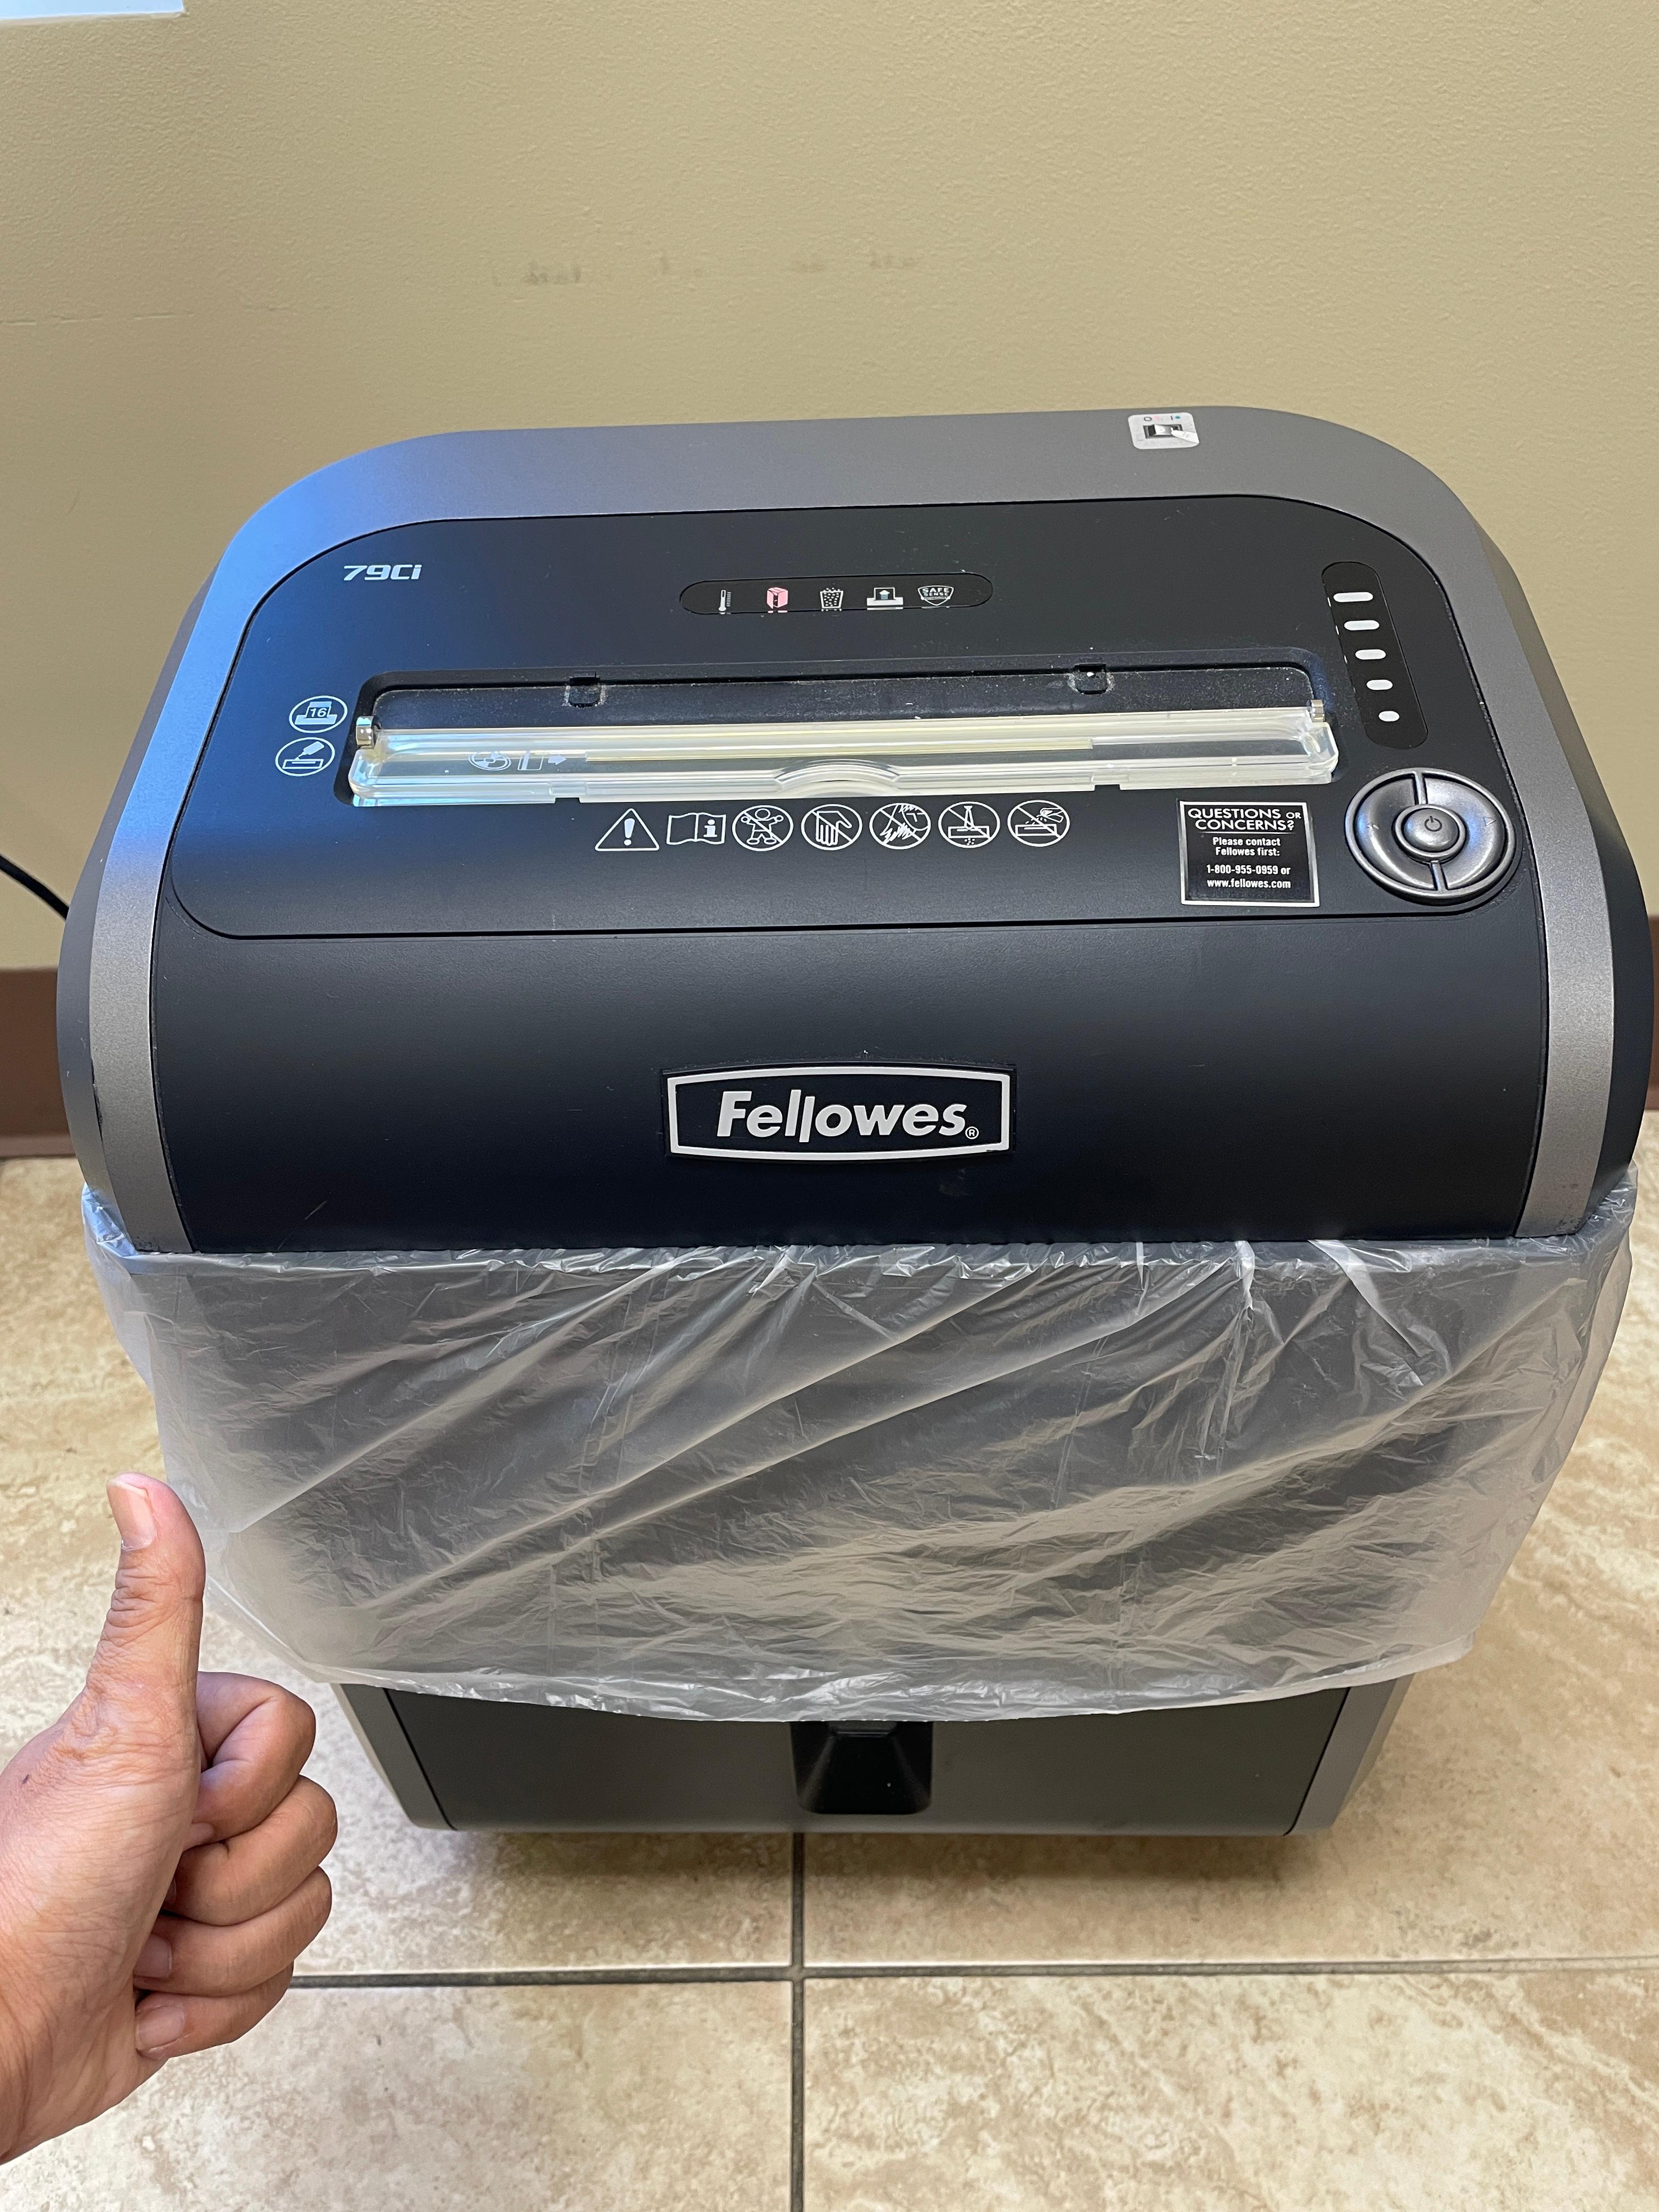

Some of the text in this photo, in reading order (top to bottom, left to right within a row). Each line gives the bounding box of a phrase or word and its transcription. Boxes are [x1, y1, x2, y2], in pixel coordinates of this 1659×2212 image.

[343, 564, 422, 580] 79Ci
[310, 708, 327, 717] 16
[1188, 808, 1281, 820] QUESTIONS
[1195, 820, 1294, 831] CONCERNS?
[1212, 837, 1280, 846] Please contact
[1216, 847, 1280, 856] Fellowes first:
[1206, 865, 1278, 874] 1-800-955-0959
[1207, 878, 1291, 888] www.fellowes.com
